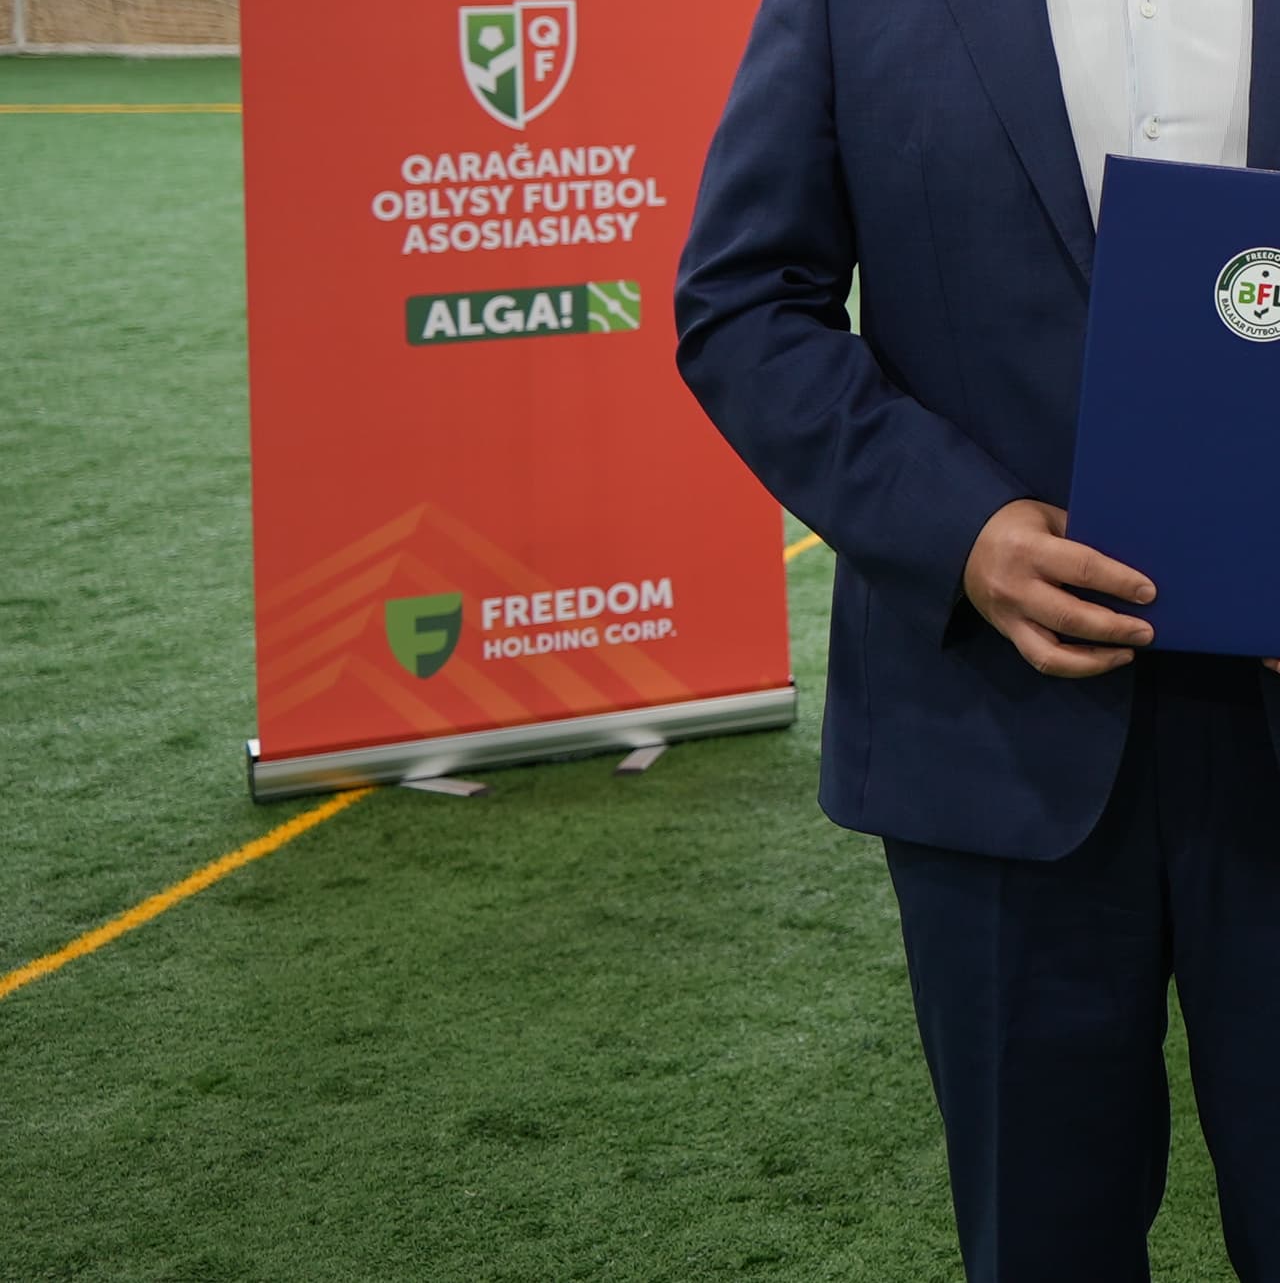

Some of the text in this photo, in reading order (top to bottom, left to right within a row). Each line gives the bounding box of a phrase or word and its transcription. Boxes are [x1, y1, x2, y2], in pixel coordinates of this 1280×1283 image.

[527, 15, 561, 47] Q
[534, 49, 555, 81] F
[400, 142, 637, 185] QARAĞANDY
[371, 178, 667, 222] OBLYSY FUTBOL
[401, 212, 640, 256] ASOSIASIASY
[421, 290, 574, 340] ALGA!
[1221, 297, 1247, 331] BALALAR
[1245, 325, 1280, 336] FUTBOL
[481, 577, 674, 631] FREEDOM
[483, 618, 678, 660] HOLDING CORP.
